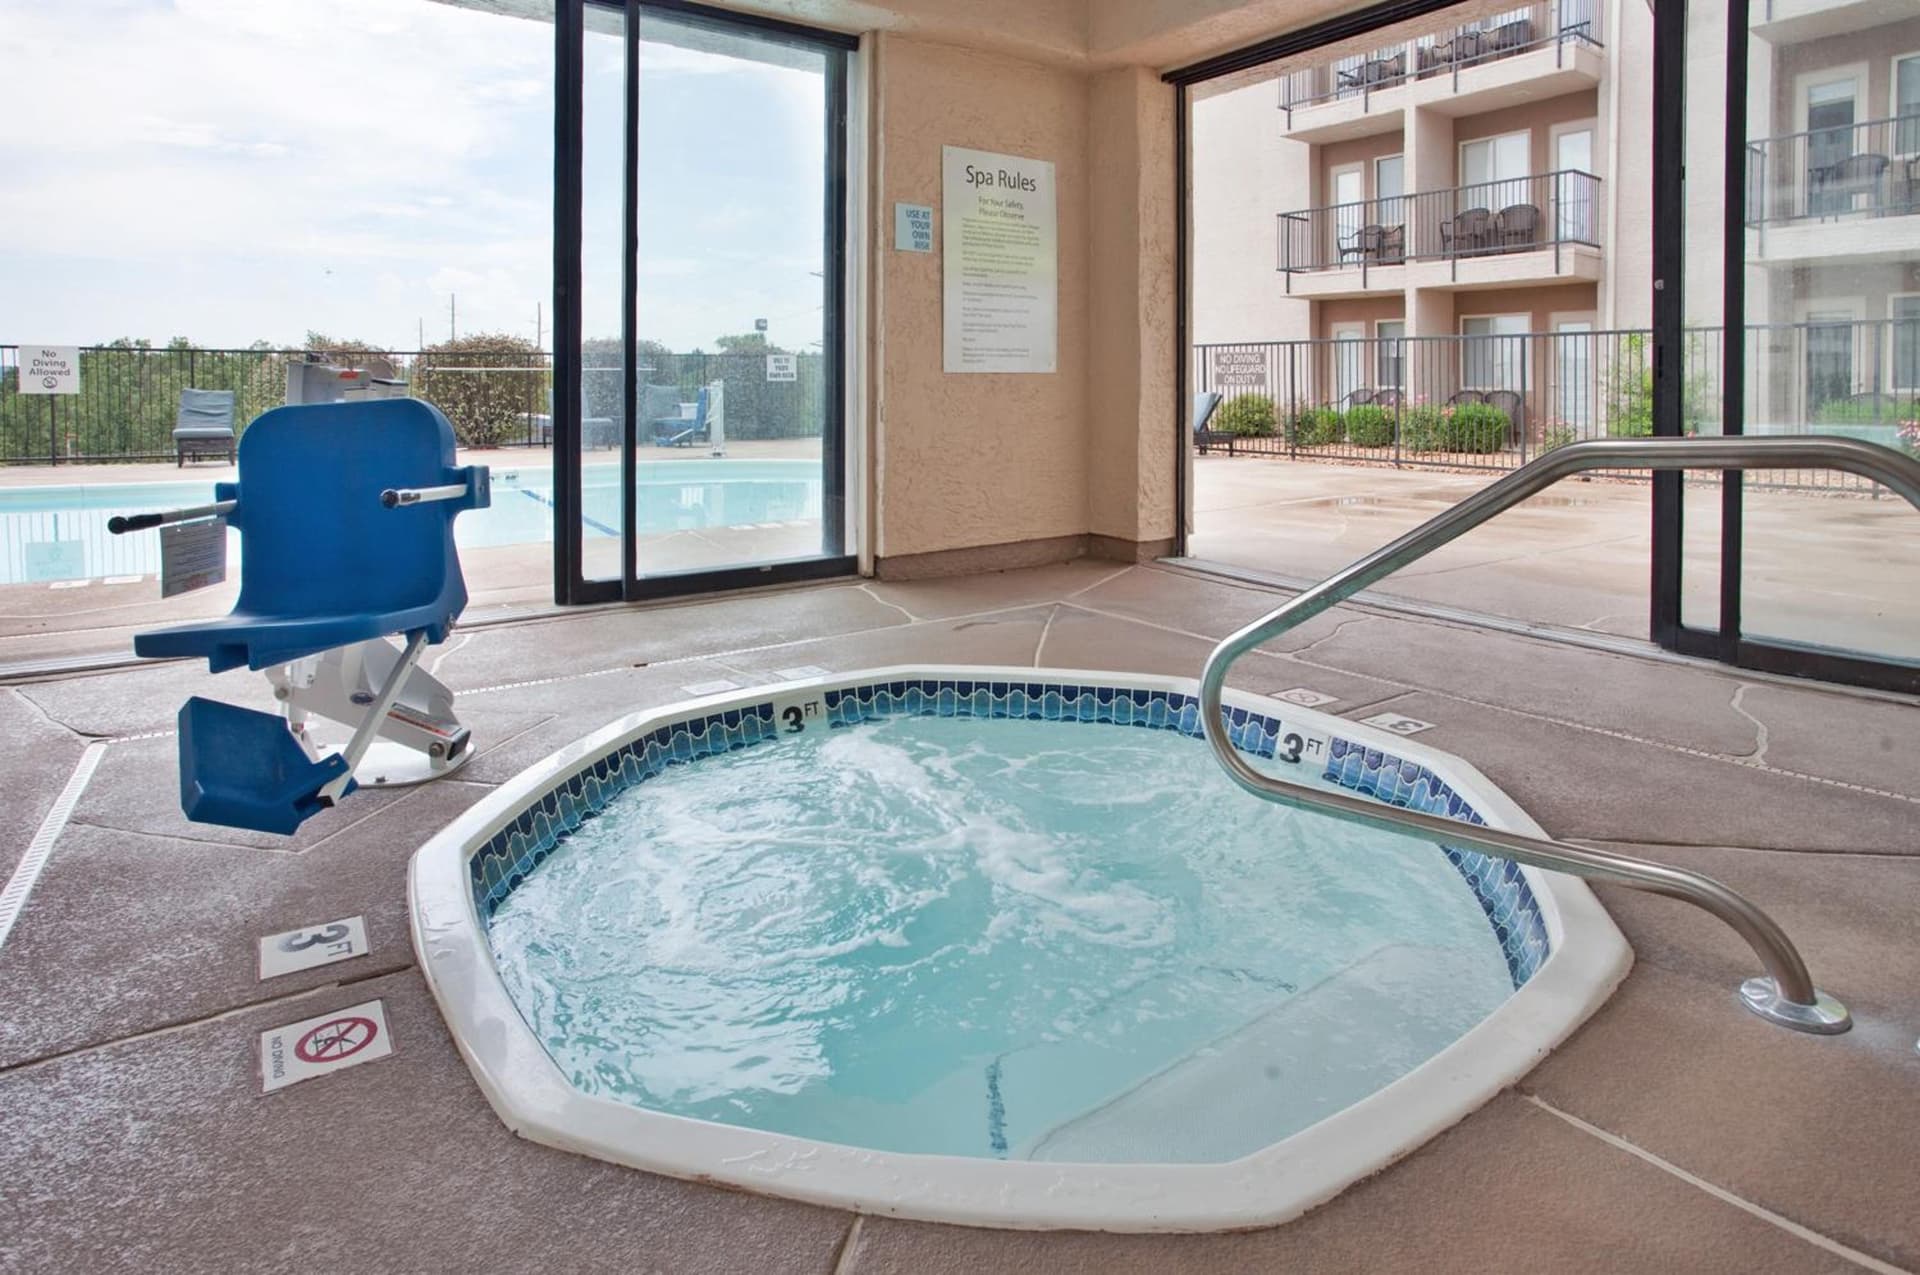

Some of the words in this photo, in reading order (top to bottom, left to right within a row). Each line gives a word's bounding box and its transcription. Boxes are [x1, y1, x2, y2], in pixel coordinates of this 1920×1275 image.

[966, 165, 993, 189] Spa
[998, 169, 1036, 192] Rules
[906, 209, 921, 219] USE
[922, 211, 930, 219] AT
[911, 219, 930, 230] YOUR
[912, 230, 930, 240] OWN
[42, 350, 56, 358] No
[1220, 354, 1231, 364] NO
[1233, 353, 1260, 363] DIVING
[33, 360, 66, 368] Diving
[1215, 364, 1225, 374] NO
[1226, 364, 1265, 374] LIFEGUARD
[29, 368, 70, 376] Allowed
[1224, 375, 1235, 384] ON
[1236, 374, 1257, 384] DUTY
[782, 706, 805, 733] 3
[804, 701, 819, 716] FT
[1280, 733, 1304, 764] 3
[1306, 738, 1324, 755] FT
[278, 924, 350, 953] 3
[327, 941, 353, 957] FT
[272, 1035, 283, 1049] NO
[272, 1049, 286, 1079] DIVING
